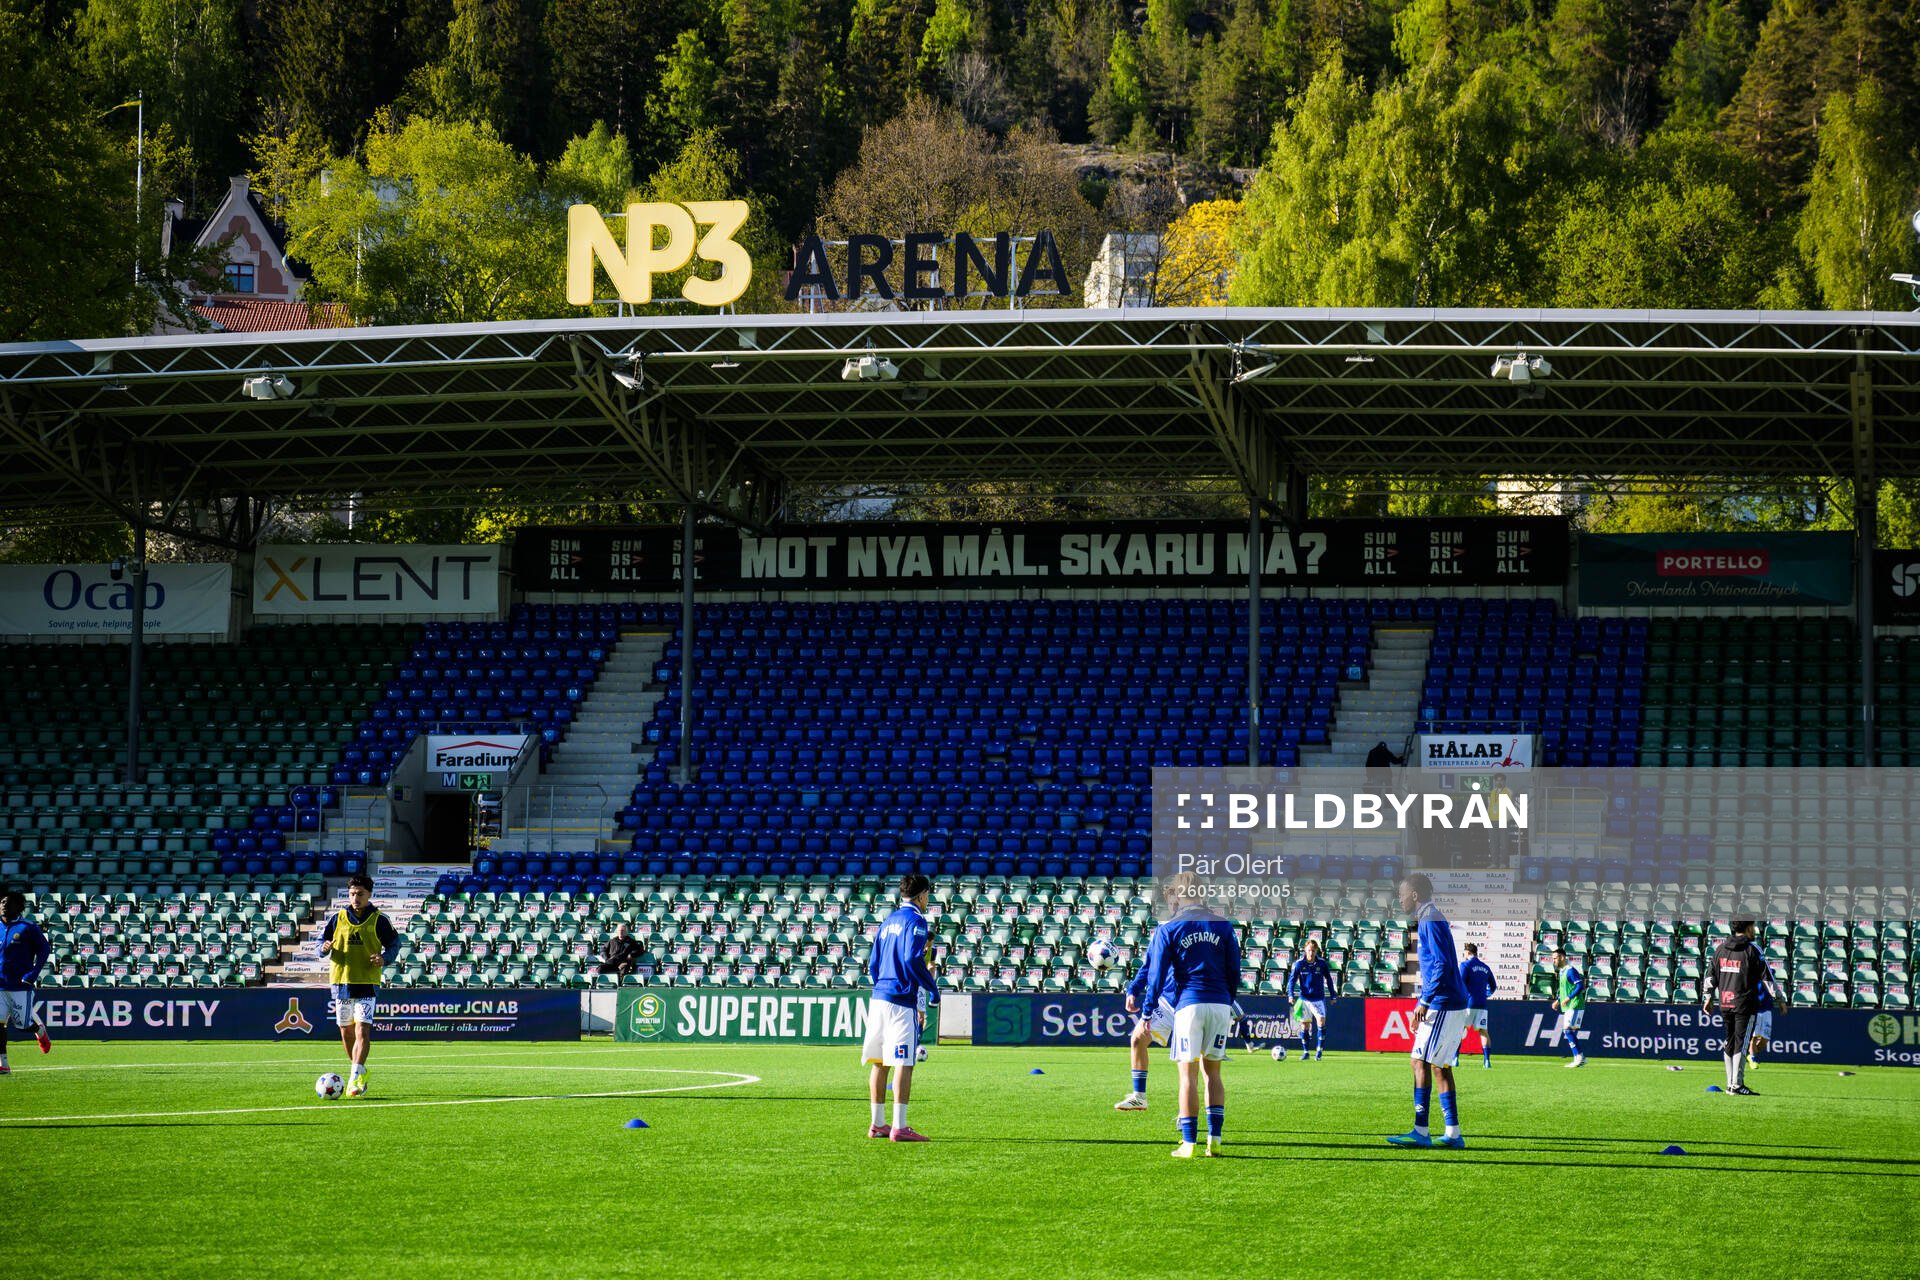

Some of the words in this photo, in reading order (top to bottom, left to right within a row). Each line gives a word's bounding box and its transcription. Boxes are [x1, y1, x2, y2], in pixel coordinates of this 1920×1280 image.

[567, 200, 752, 306] NP3
[784, 230, 1072, 300] ARENA
[1364, 532, 1397, 545] SUN
[1430, 531, 1463, 545] SUN
[1497, 530, 1529, 543] SUN
[551, 539, 581, 551] SUN
[611, 540, 643, 551] SUN
[673, 539, 704, 551] SN
[741, 537, 837, 578] MOT
[848, 535, 933, 577] NYA
[943, 527, 1049, 576] MÅL.
[1060, 533, 1215, 576] SKARU
[1364, 561, 1397, 575] ALL
[1430, 561, 1463, 574] ALL
[1497, 560, 1530, 573] ALL
[1663, 556, 1763, 570] PORTELLO
[264, 556, 492, 601] XLENT
[550, 567, 580, 580] ALL
[611, 567, 641, 580] ALL
[672, 567, 702, 580] AL
[43, 569, 165, 611] Ocab
[1626, 580, 1697, 597] Norrlands
[1700, 580, 1800, 598] Nationaldryck
[48, 620, 75, 630] Saving
[76, 620, 100, 629] value,
[102, 619, 132, 630] helping
[1429, 740, 1503, 758] HÅLAB
[436, 753, 518, 767] Faradium
[443, 773, 456, 786] M
[1181, 931, 1220, 949] GIFFARNA
[32, 1000, 132, 1027] KEBAB
[143, 1000, 220, 1027] CITY
[463, 1001, 493, 1014] JCN
[496, 1001, 518, 1014] AB
[642, 998, 655, 1015] S
[677, 994, 872, 1037] SUPERETTAN
[1652, 1009, 1692, 1026] The
[1698, 1010, 1723, 1027] be
[395, 1024, 410, 1032] och
[413, 1024, 448, 1032] metaller
[456, 1024, 478, 1032] olika
[1603, 1031, 1699, 1055] shopping
[1705, 1038, 1822, 1054] exience
[1874, 1049, 1920, 1065] Skog
